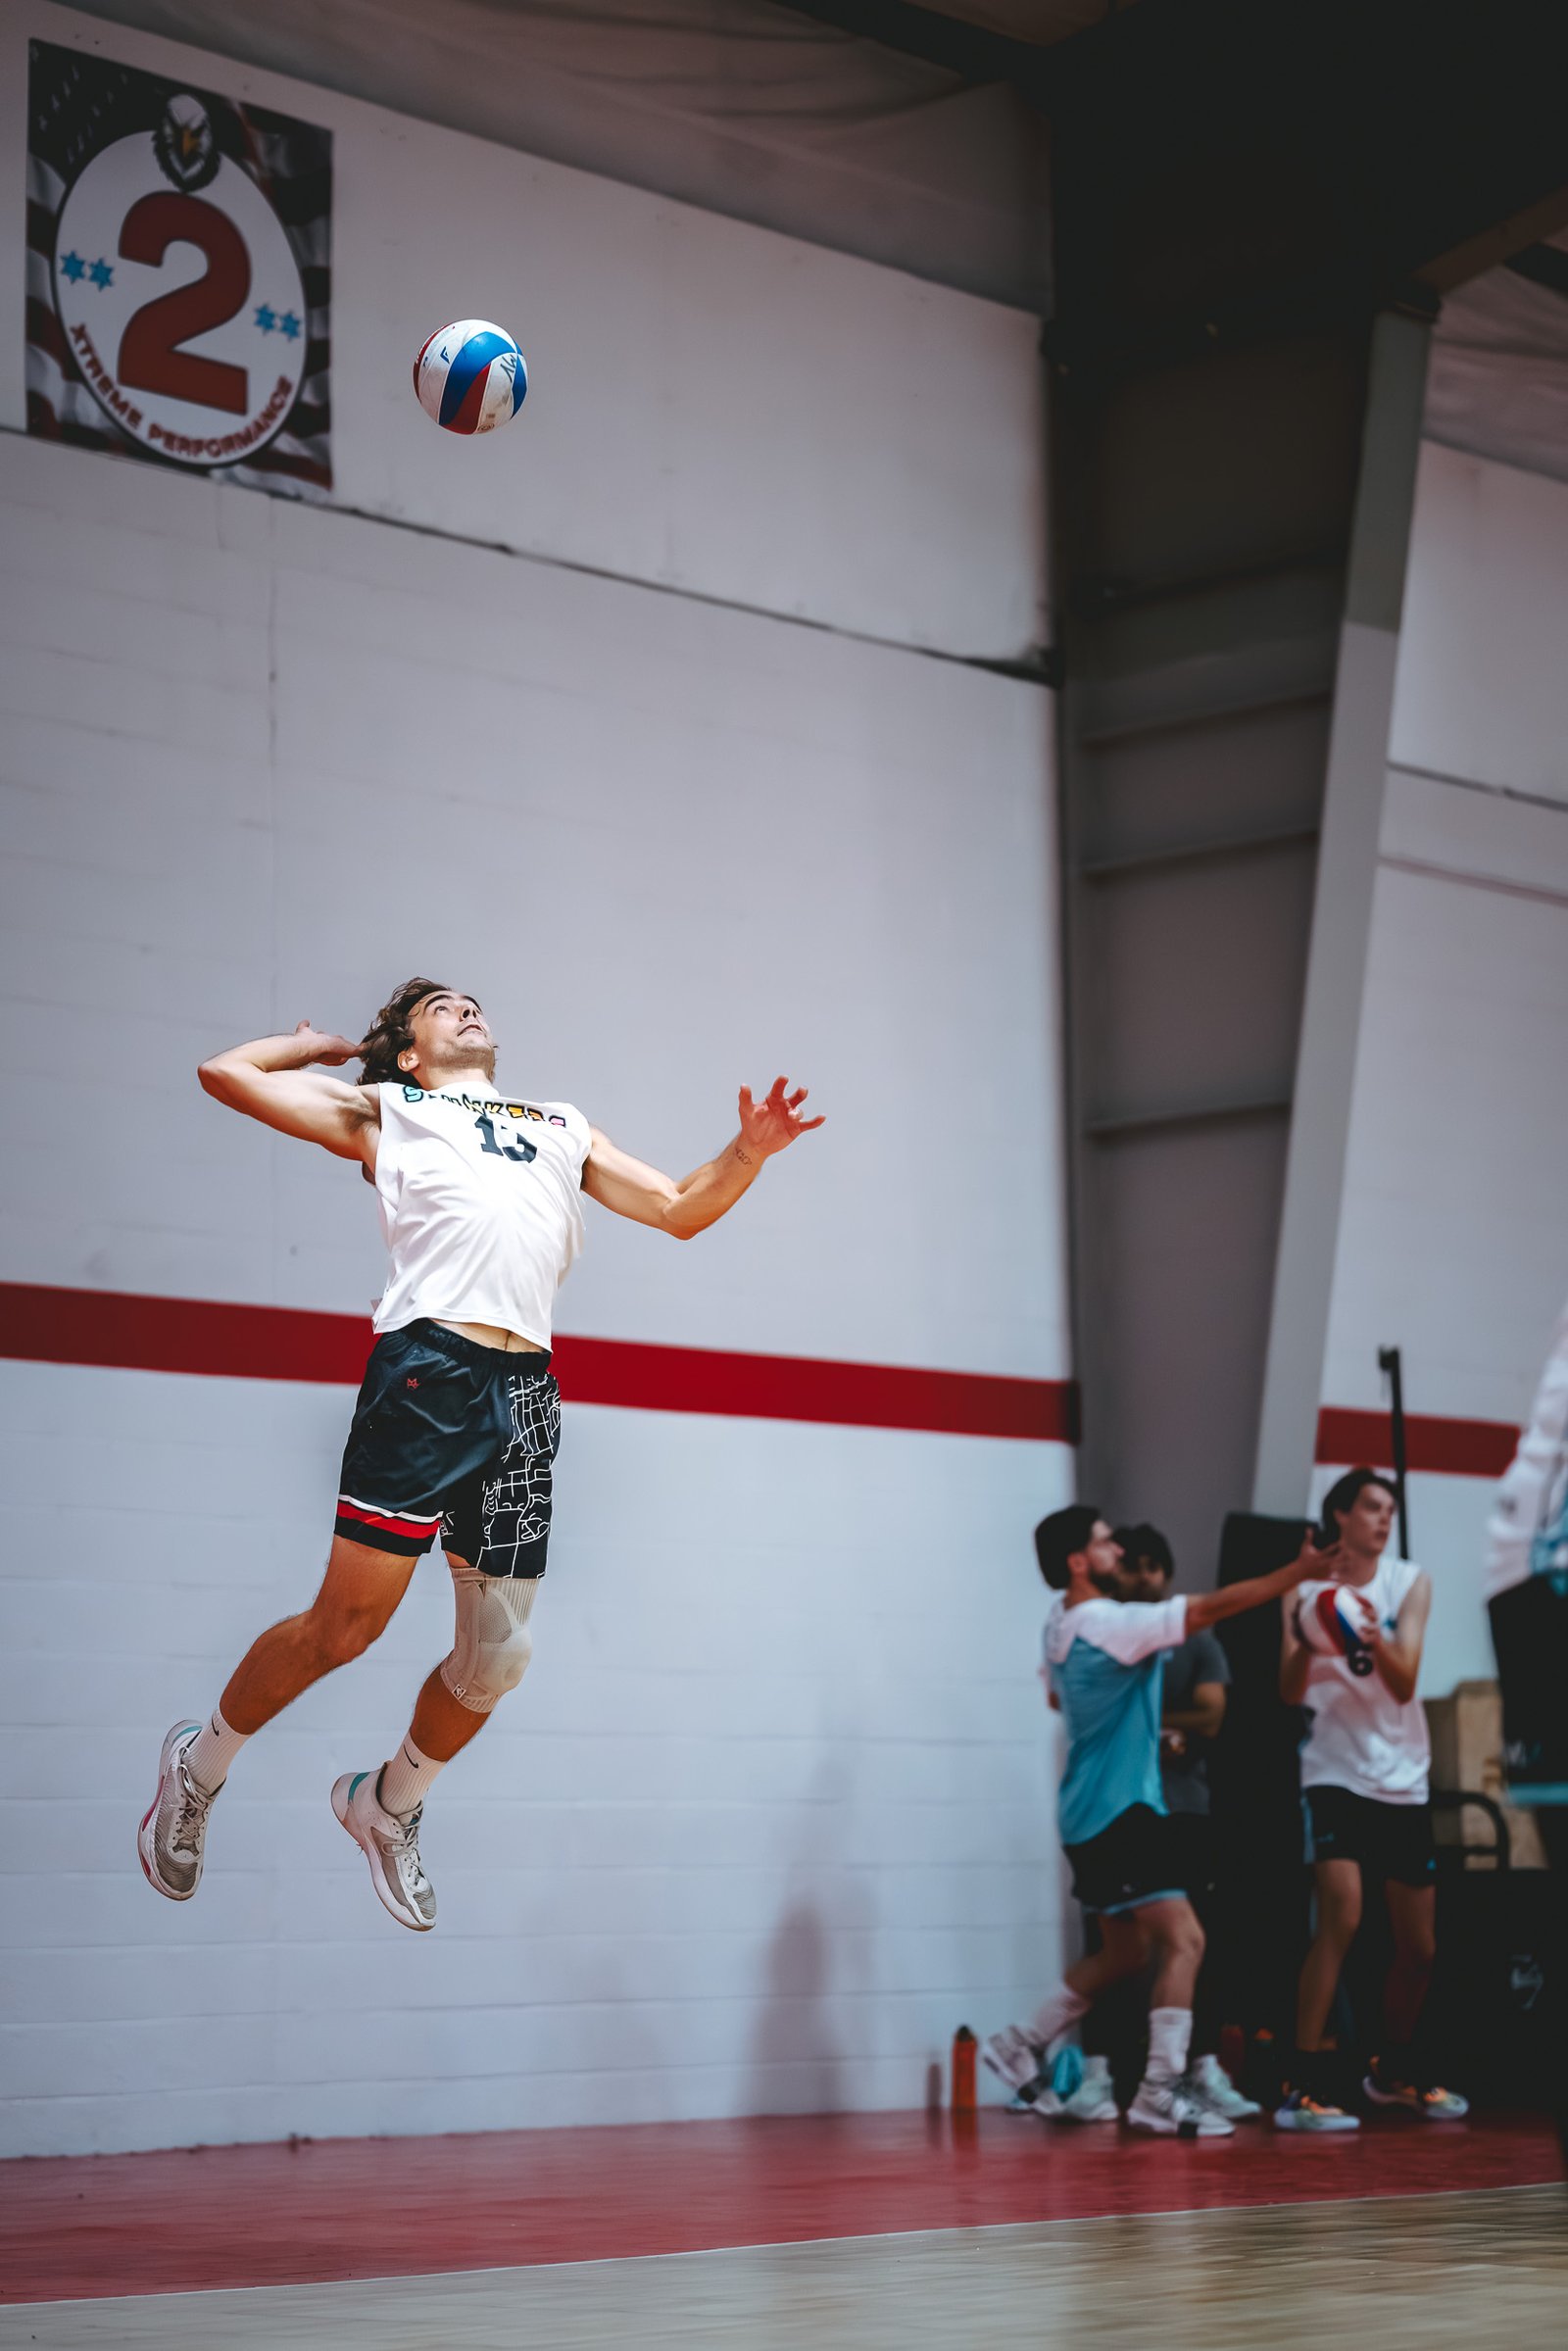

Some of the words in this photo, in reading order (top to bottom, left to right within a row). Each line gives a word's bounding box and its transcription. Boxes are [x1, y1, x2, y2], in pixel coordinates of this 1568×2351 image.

[71, 323, 143, 428] XTREME
[148, 375, 293, 458] PERFORMANCE
[118, 191, 252, 416] 2
